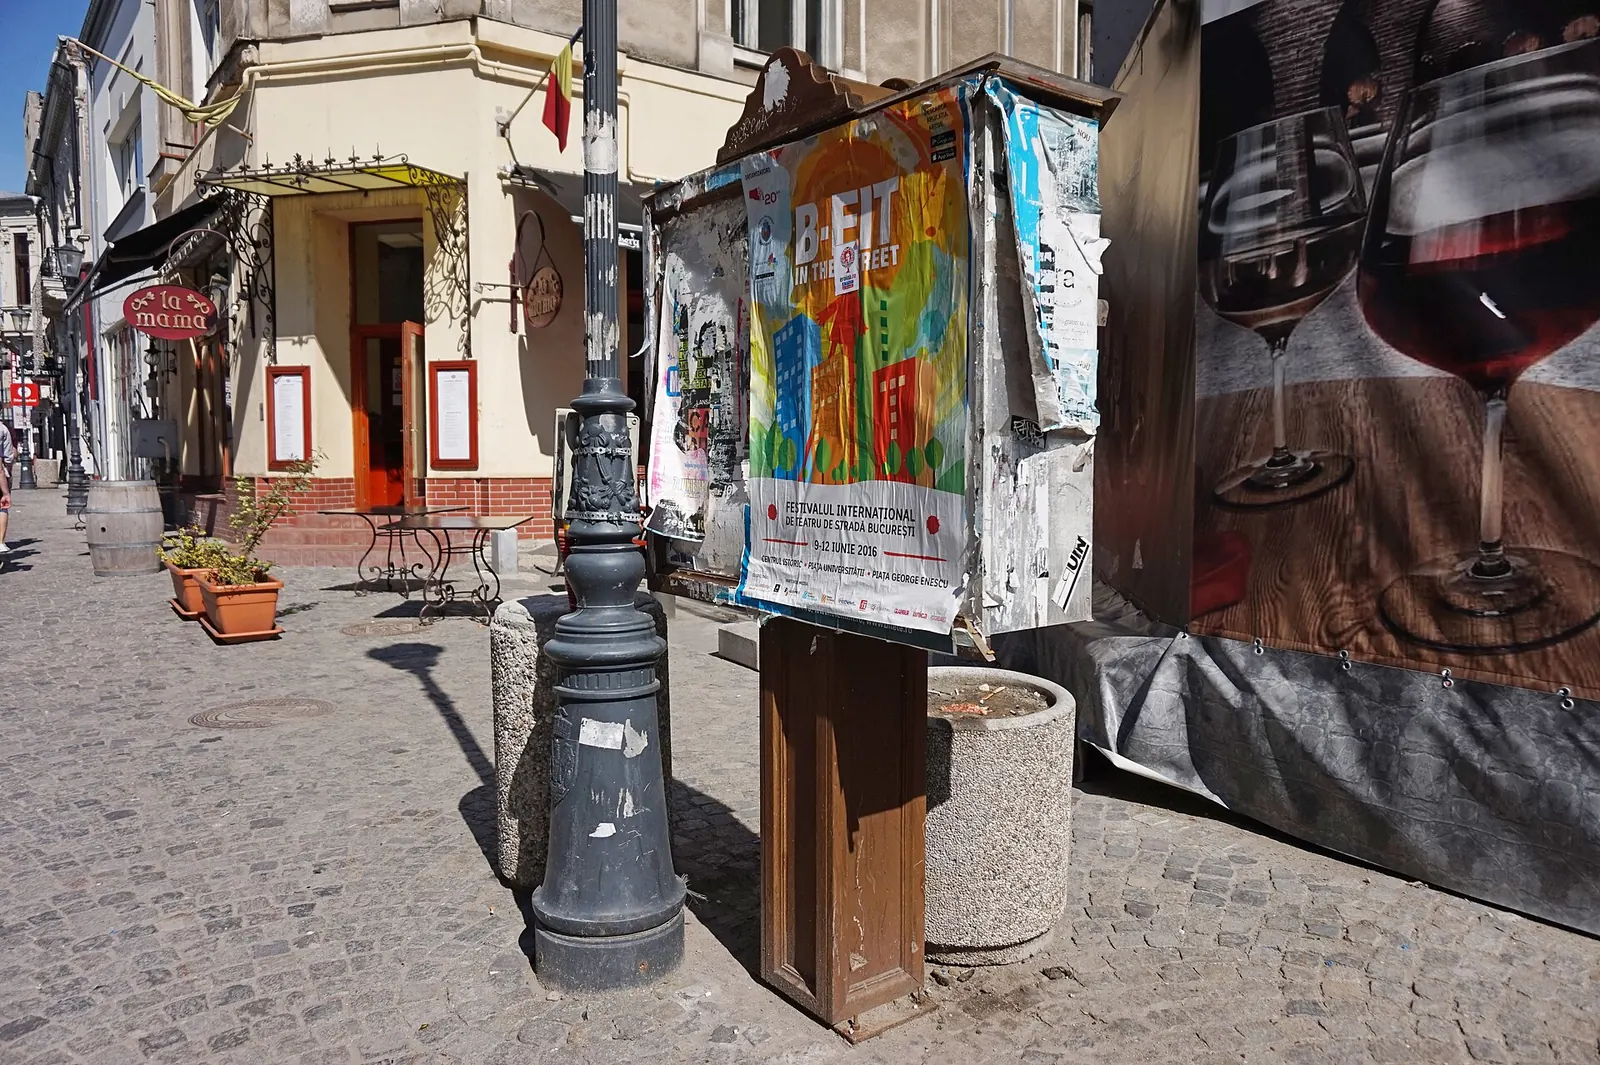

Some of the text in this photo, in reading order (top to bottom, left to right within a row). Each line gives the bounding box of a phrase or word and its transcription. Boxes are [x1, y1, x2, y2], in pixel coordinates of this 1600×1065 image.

[795, 176, 899, 265] B-FIT
[795, 266, 808, 286] IN
[160, 291, 181, 311] la
[136, 312, 207, 330] mama
[786, 501, 834, 516] FESTIVALUL
[786, 517, 794, 526] DE
[795, 517, 821, 529] TEATRU
[823, 519, 833, 530] DE
[814, 540, 878, 558] 9-12 IUNIE 2016
[891, 573, 919, 585] GEORGE
[921, 577, 949, 589] ENESCU
